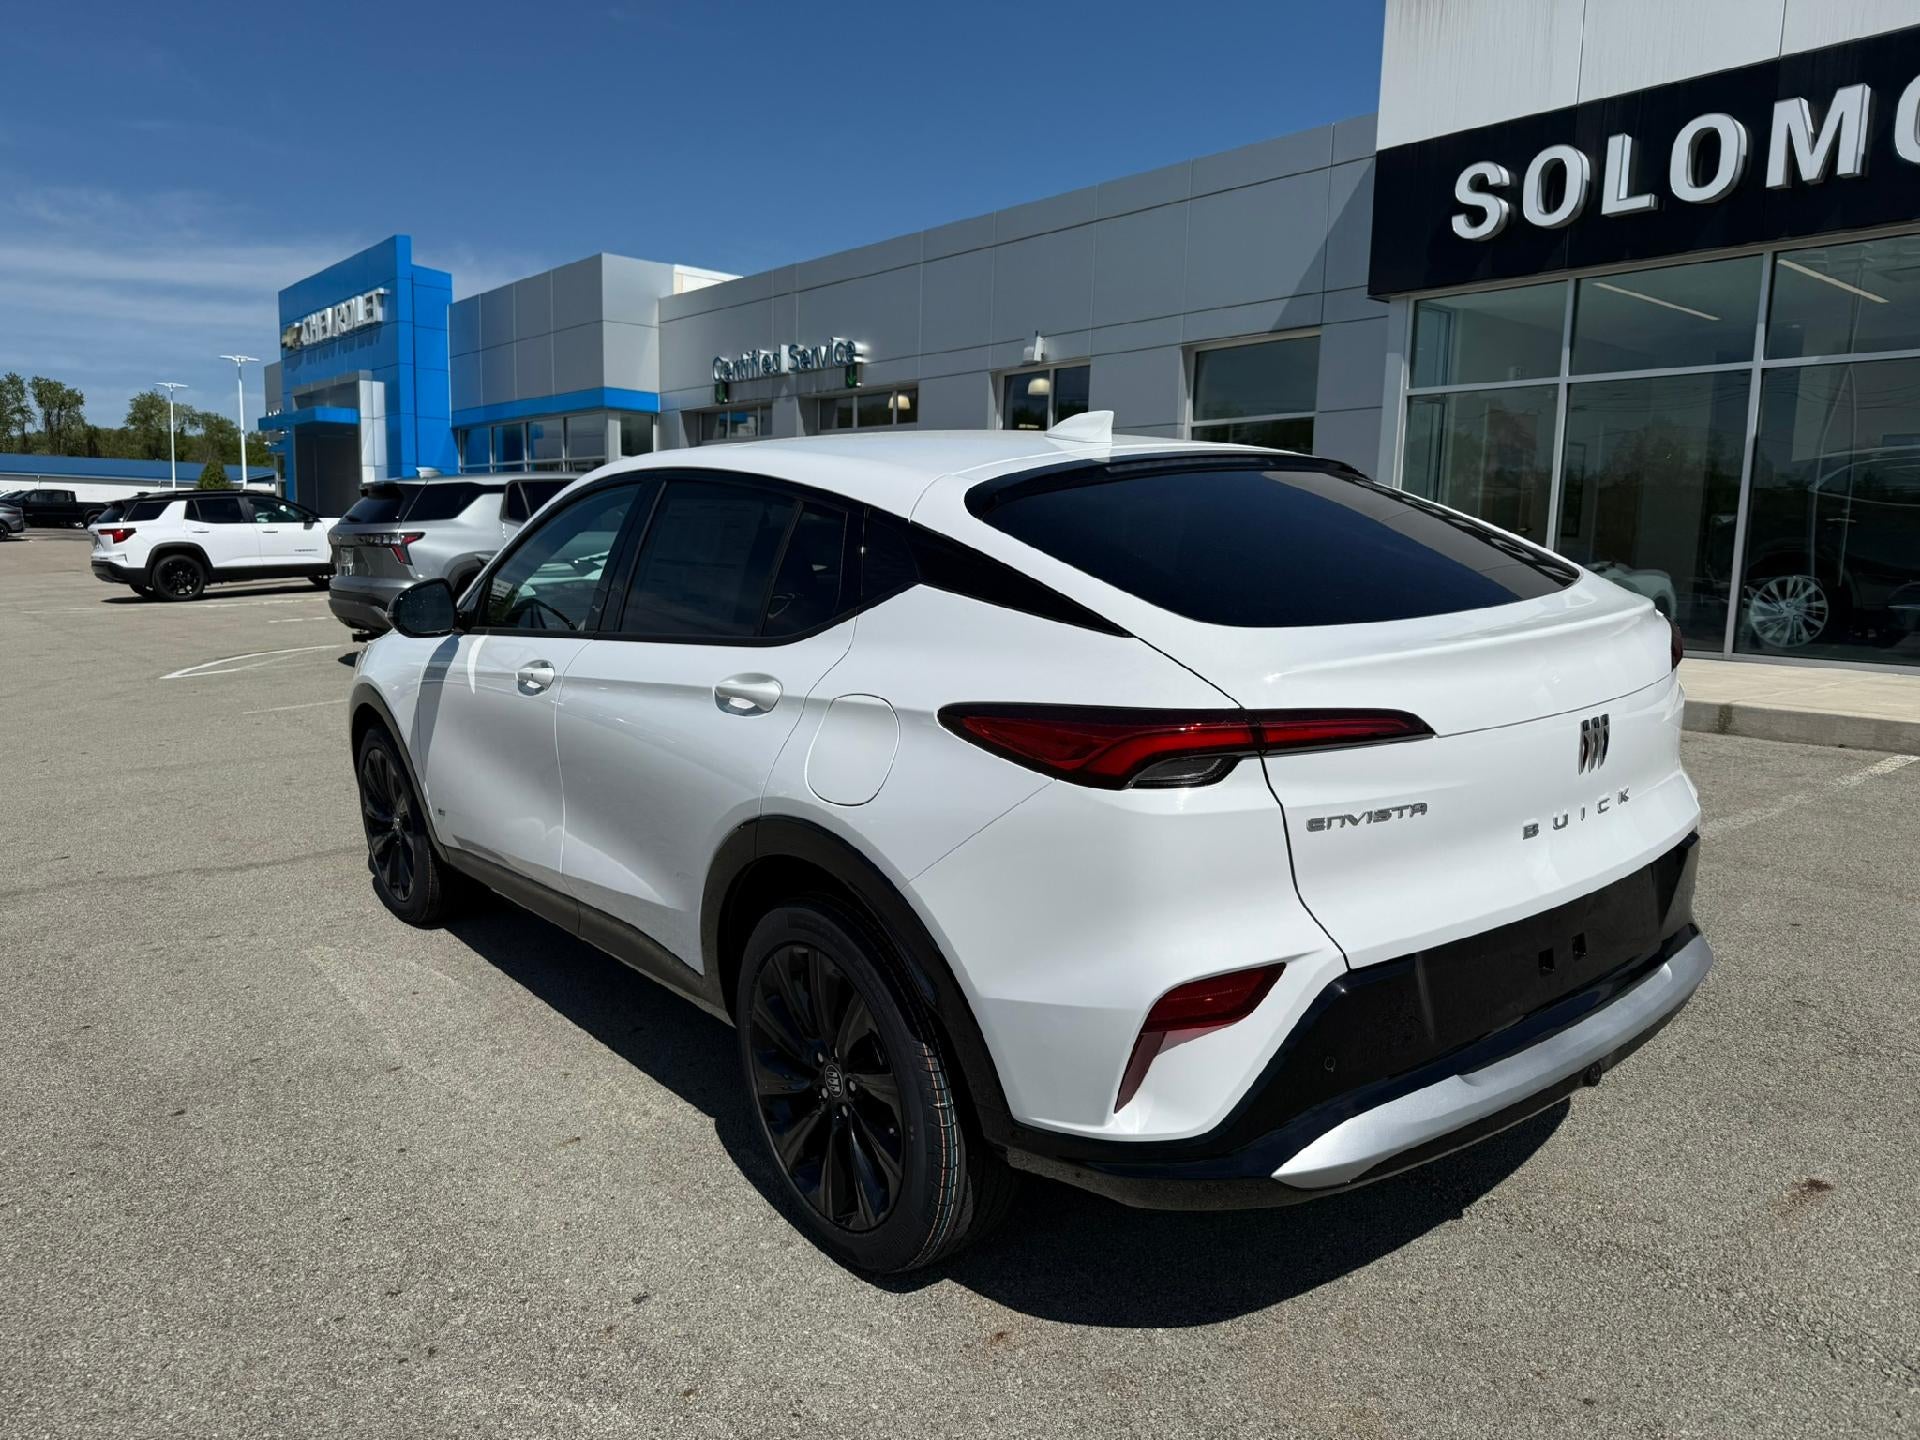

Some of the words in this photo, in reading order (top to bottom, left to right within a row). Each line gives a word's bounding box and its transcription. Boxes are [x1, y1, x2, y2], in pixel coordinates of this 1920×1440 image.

[712, 345, 788, 382] Certified
[787, 337, 866, 373] Service
[1305, 802, 1428, 832] ENVISTA
[1522, 786, 1631, 840] BUICK
